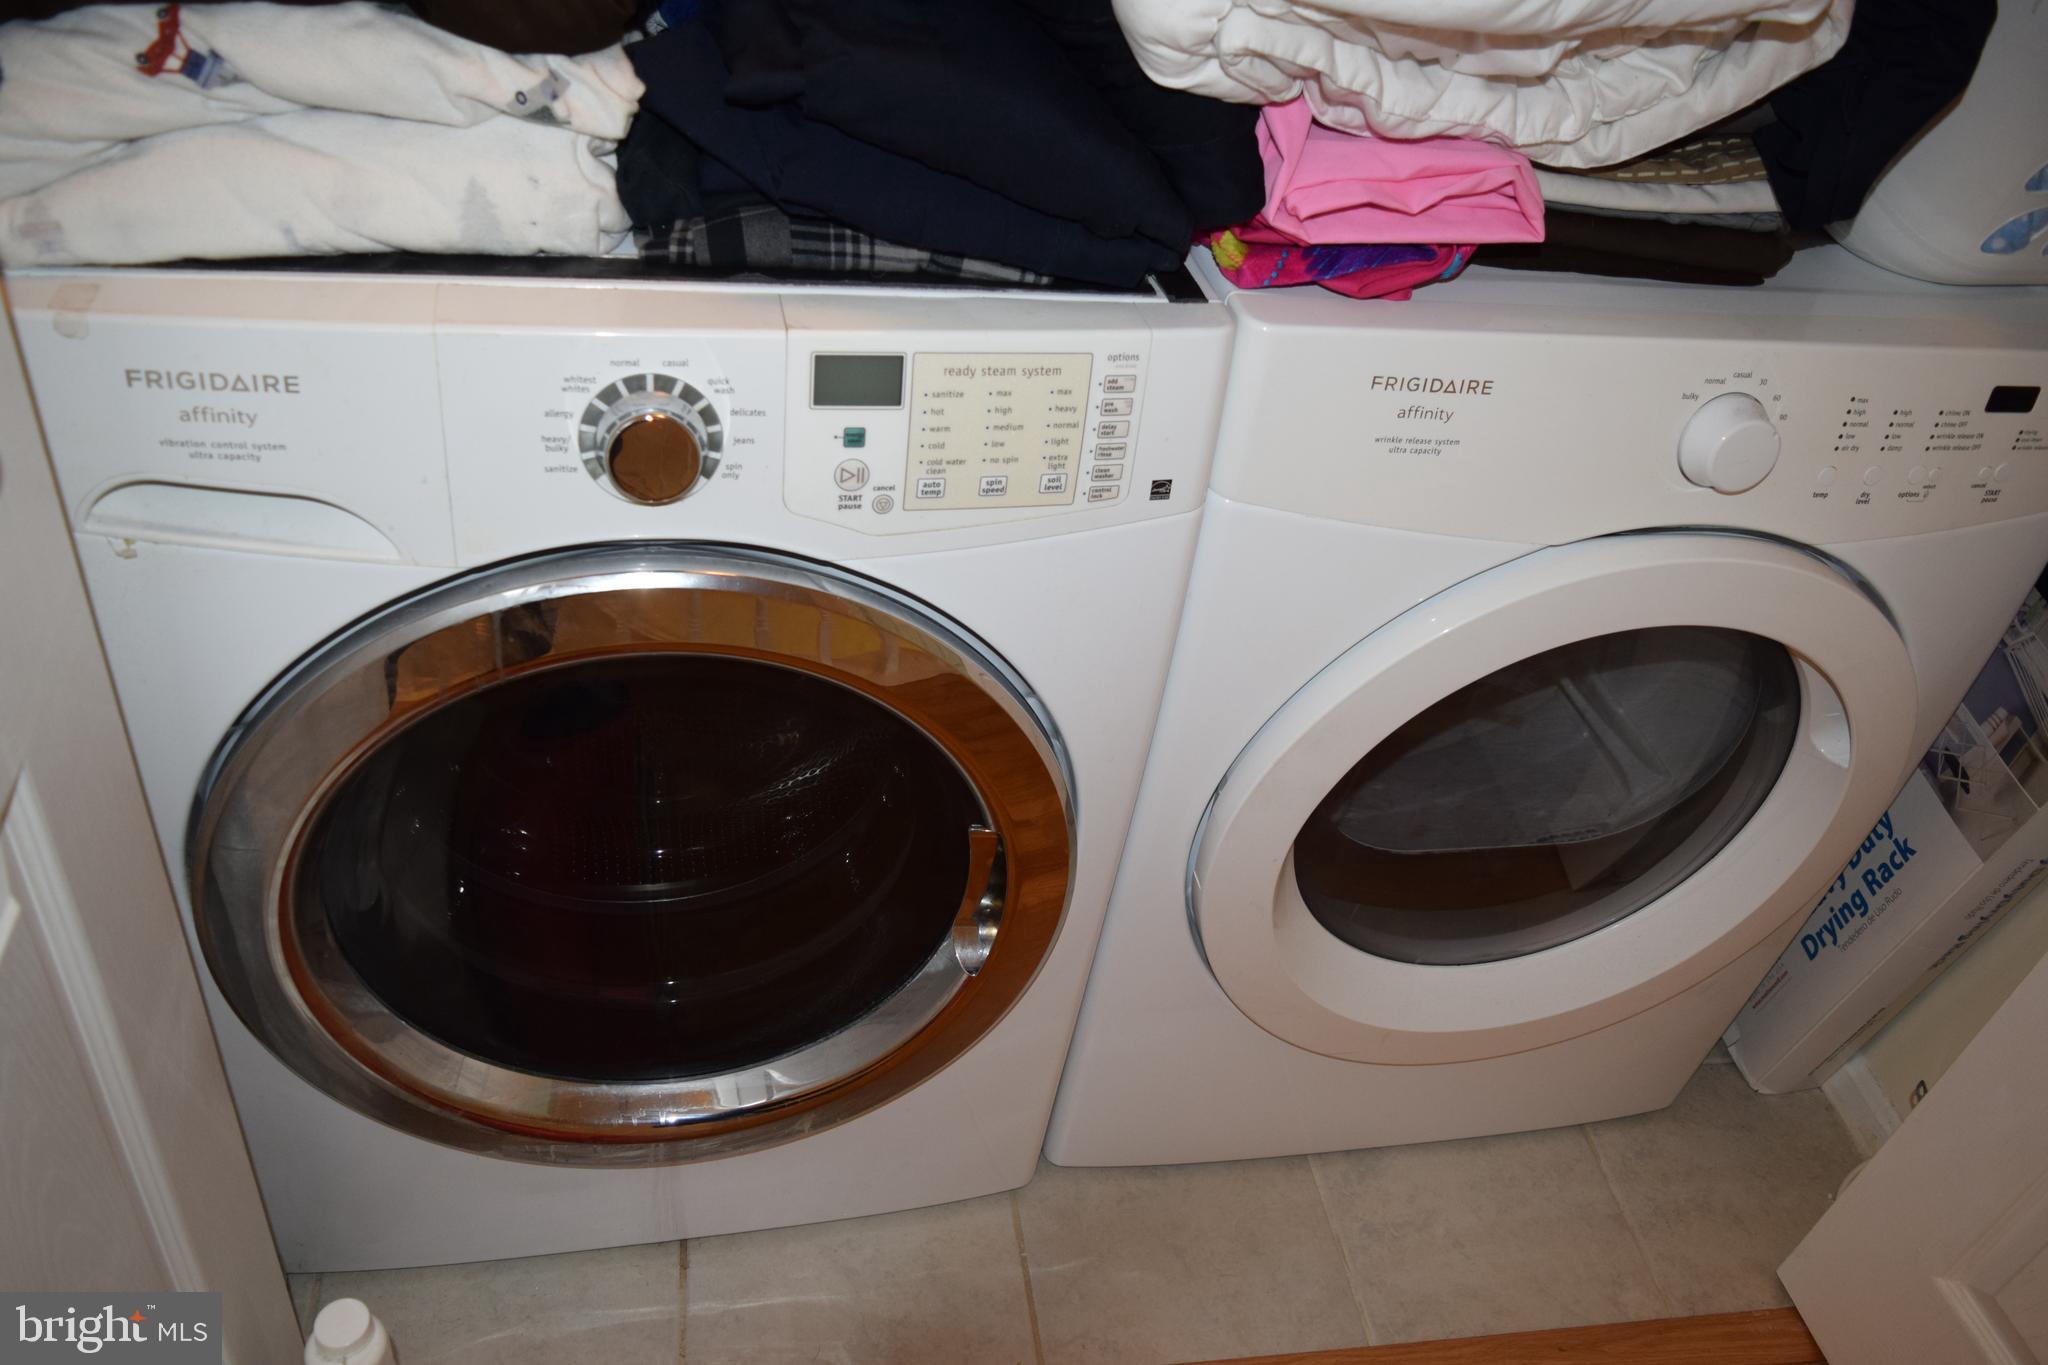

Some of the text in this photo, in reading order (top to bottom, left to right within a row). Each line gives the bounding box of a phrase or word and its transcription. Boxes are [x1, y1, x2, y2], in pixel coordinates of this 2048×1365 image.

[1107, 352, 1140, 363] options
[610, 358, 640, 367] normal
[662, 358, 689, 367] casual
[943, 365, 1062, 379] ready steam system
[1733, 371, 1753, 379] casual
[124, 368, 301, 394] FRIGIDAIRE
[563, 375, 597, 385] whitest
[707, 377, 730, 387] quick
[561, 384, 590, 394] whites
[1371, 375, 1494, 395] FRIGIDAIRE
[713, 386, 735, 395] wash
[932, 390, 964, 399] sanitize
[729, 407, 766, 417] delicates
[931, 408, 944, 416] hot
[995, 407, 1012, 415] high
[1055, 405, 1078, 414] heavy
[179, 406, 258, 428] affinity
[1397, 405, 1454, 424] affinity
[993, 423, 1024, 431] medium
[1053, 422, 1080, 430] normal
[159, 438, 287, 452] vibration control system
[732, 436, 755, 446] jeans
[991, 440, 1005, 448] low
[1051, 438, 1069, 447] light
[1375, 436, 1461, 447] wrinkle release system
[545, 443, 568, 454] bulky
[928, 442, 945, 450] cold
[189, 450, 261, 463] ultra capacity
[1410, 448, 1442, 456] capacity
[926, 458, 966, 466] cold water
[1002, 456, 1019, 464] spin
[1048, 454, 1068, 462] extra
[544, 464, 578, 473] sanitize
[725, 462, 742, 473] spin
[1048, 462, 1066, 470] light
[926, 467, 947, 475] clean
[721, 471, 740, 481] only
[1047, 476, 1062, 484] soil
[986, 479, 1002, 488] spin
[1044, 483, 1062, 492] level
[921, 488, 942, 497] temp
[982, 486, 1006, 495] speed
[838, 494, 863, 502] START
[1801, 888, 1869, 961] Drying
[1861, 837, 1917, 897] Rack
